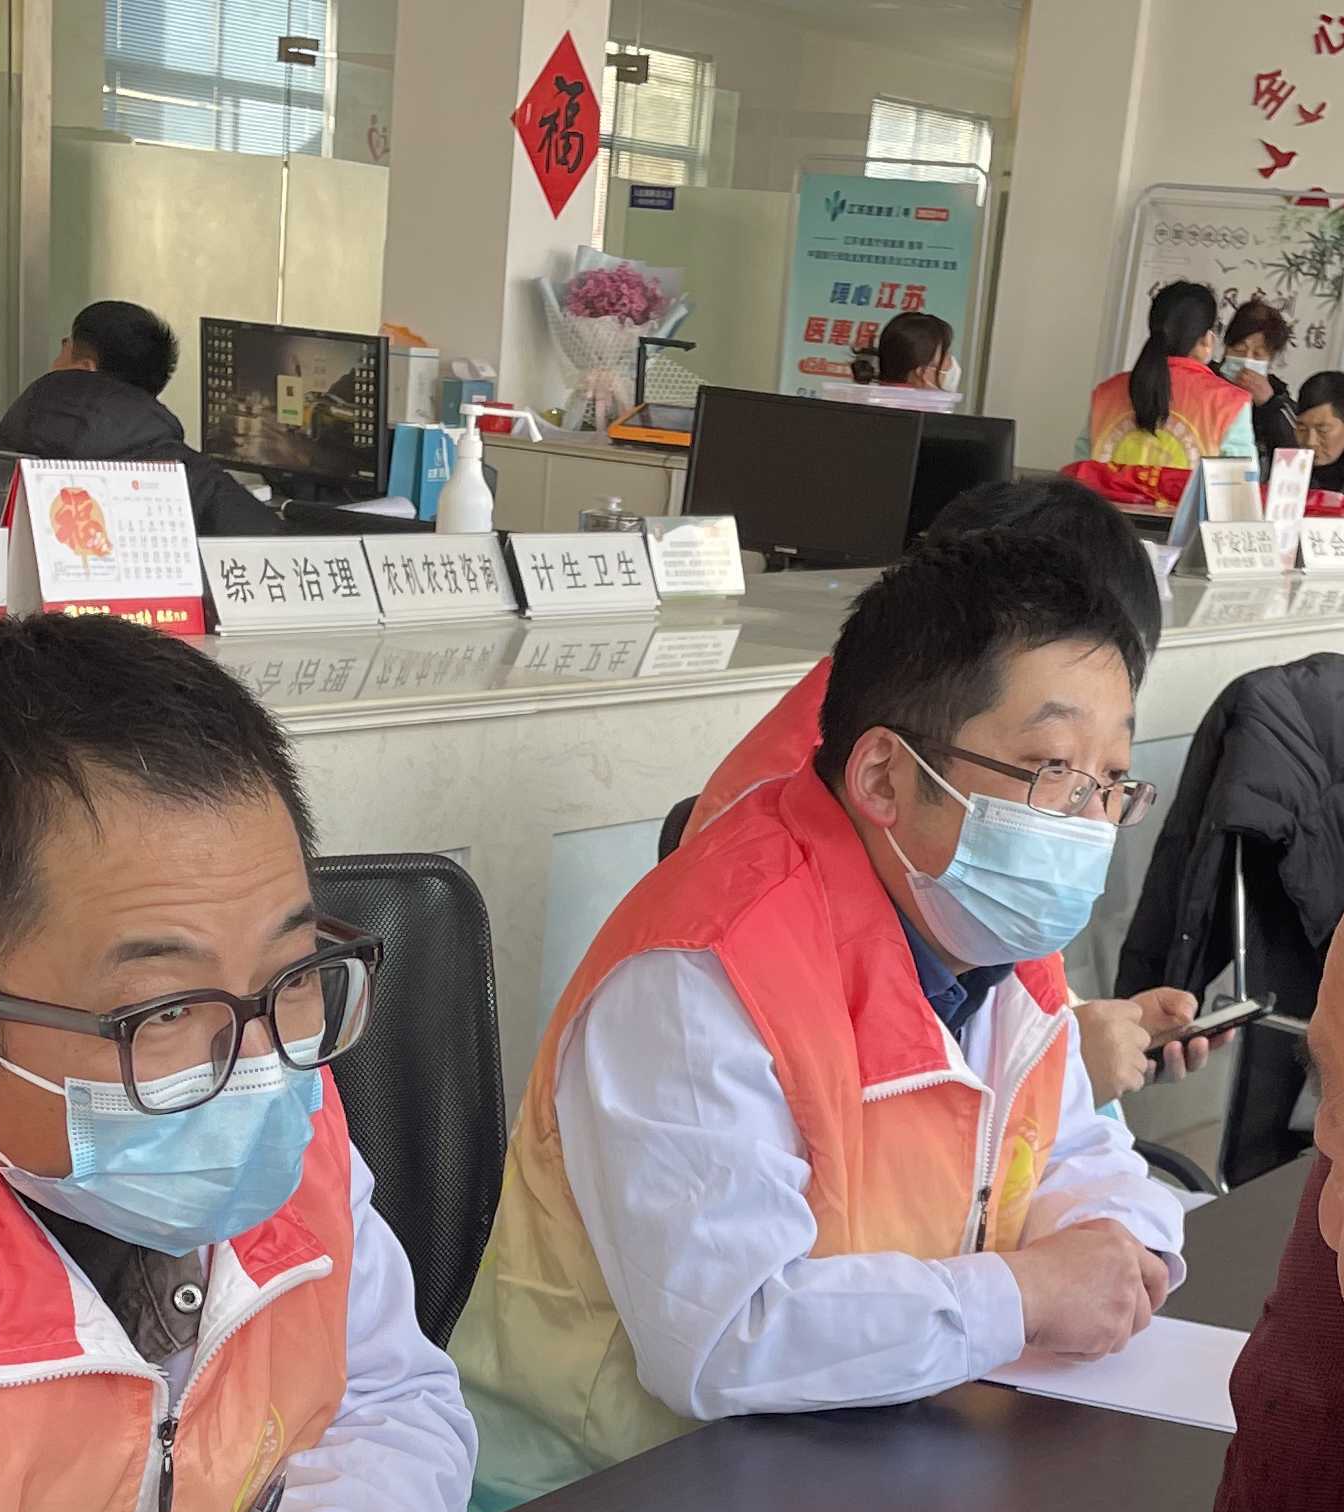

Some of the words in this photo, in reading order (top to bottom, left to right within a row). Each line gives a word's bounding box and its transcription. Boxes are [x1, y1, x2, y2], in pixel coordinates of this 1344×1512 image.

[537, 76, 585, 174] 福
[220, 556, 361, 604] 综合治理
[381, 551, 500, 596] 农机农技咨询
[530, 550, 642, 593] 计生卫生
